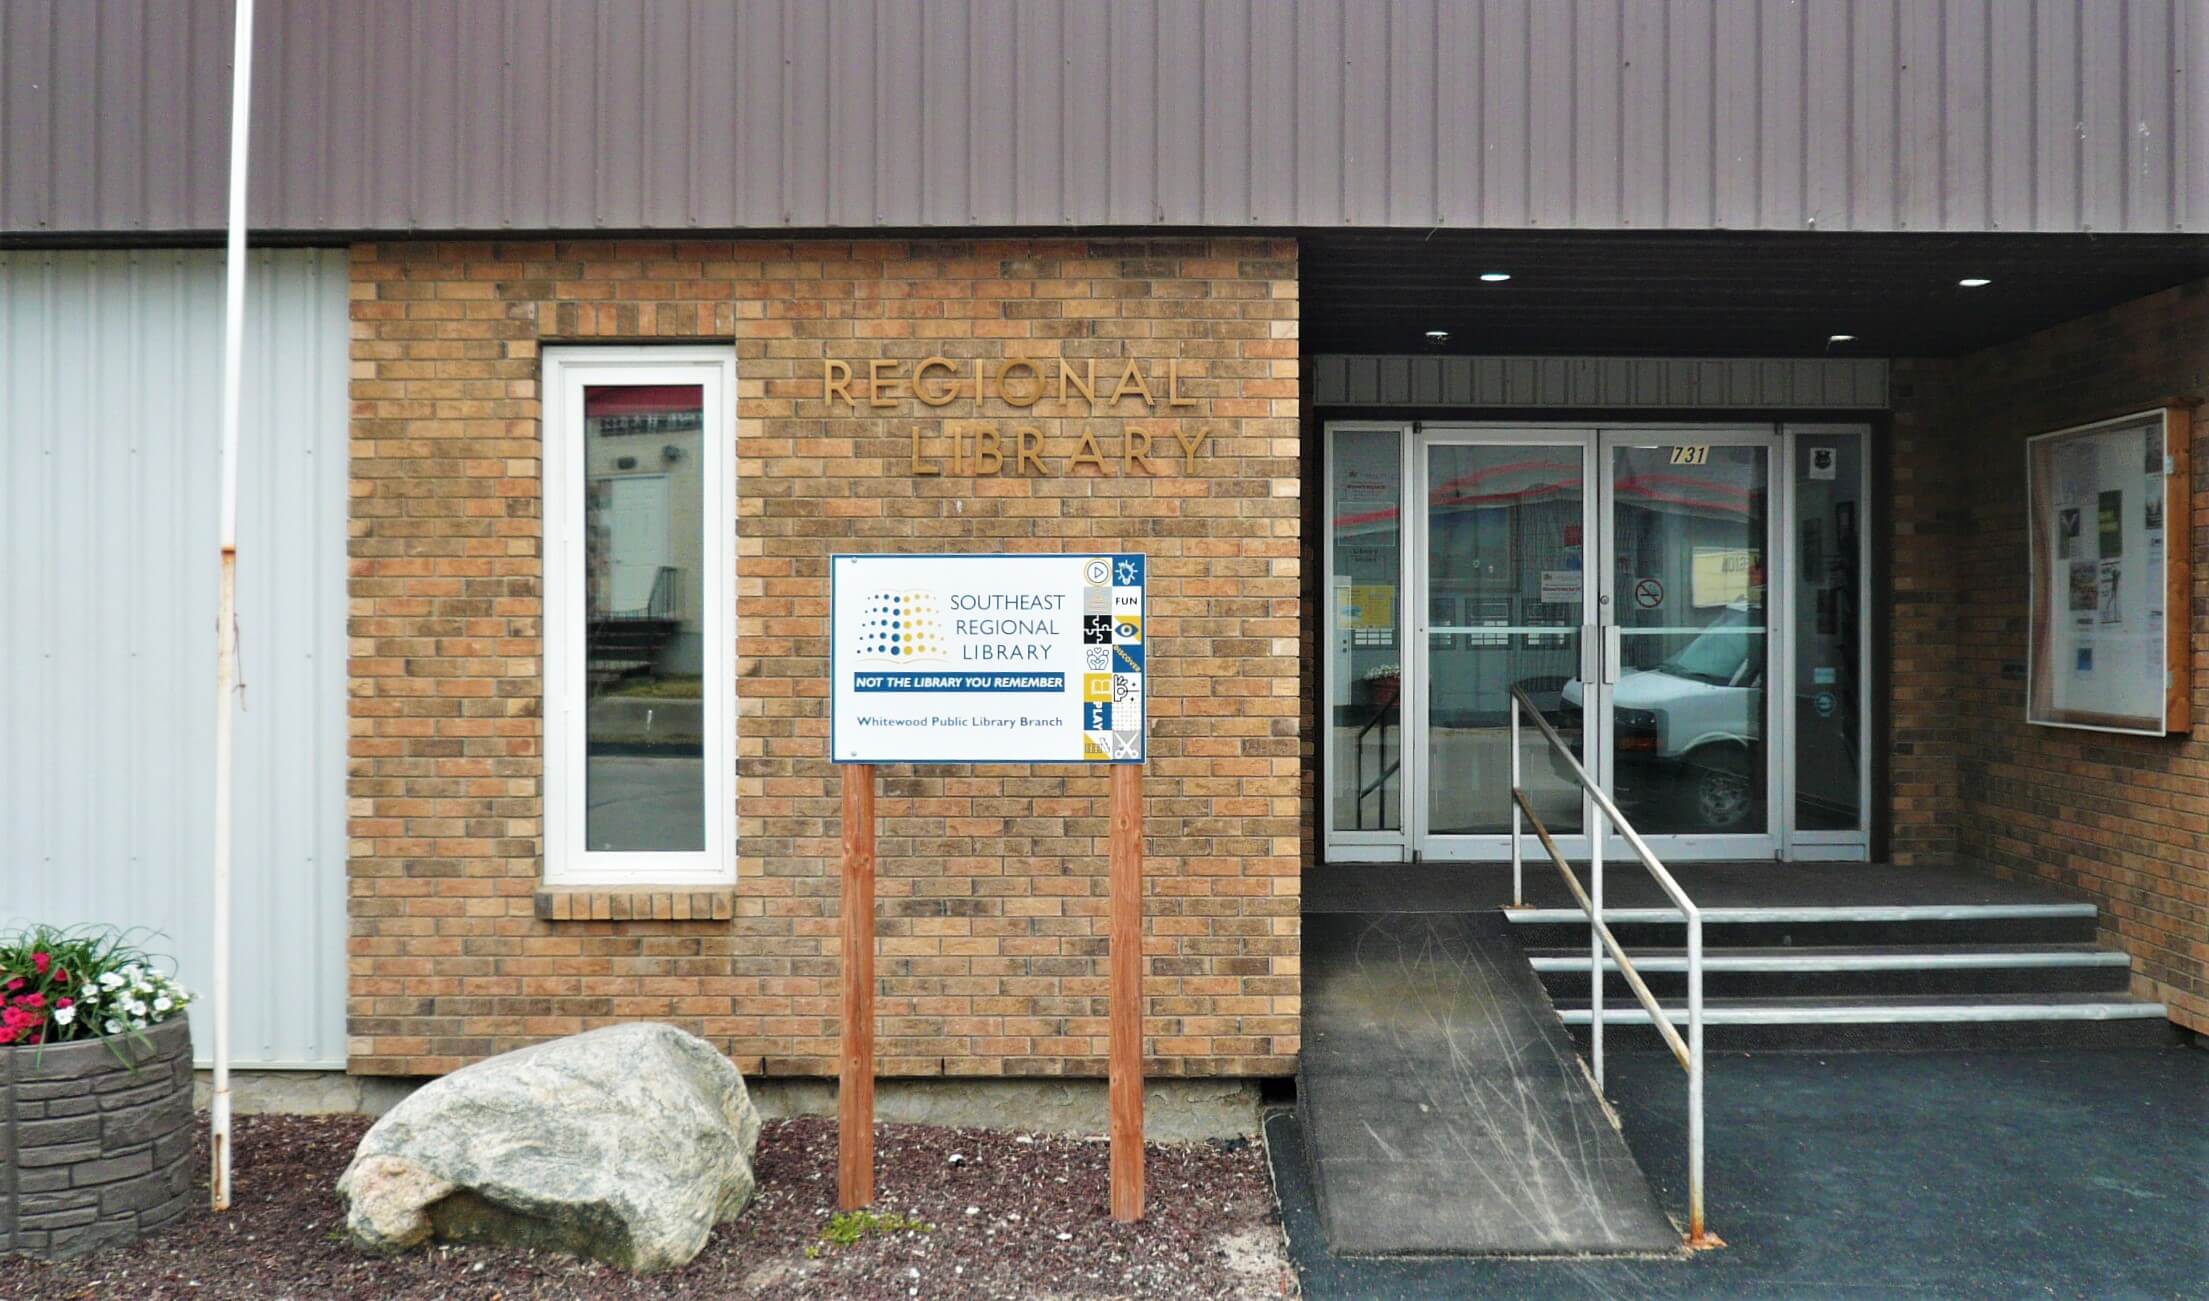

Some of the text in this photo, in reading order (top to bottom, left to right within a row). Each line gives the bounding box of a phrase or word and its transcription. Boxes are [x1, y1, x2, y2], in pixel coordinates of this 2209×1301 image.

[824, 356, 1197, 407] REGIONAL
[911, 425, 1210, 476] LIBRARY
[1673, 446, 1705, 463] 731
[950, 594, 1066, 610] SOUTHEAST
[1115, 596, 1138, 605] FUN
[956, 619, 1060, 635] REGIONAL
[963, 644, 1052, 660] LIBRARY
[856, 677, 1063, 688] NOT THE LIBRARY YOU REMEMBER
[857, 716, 1063, 729] Whitewood Public Library Branch
[1092, 700, 1104, 731] PLAY
